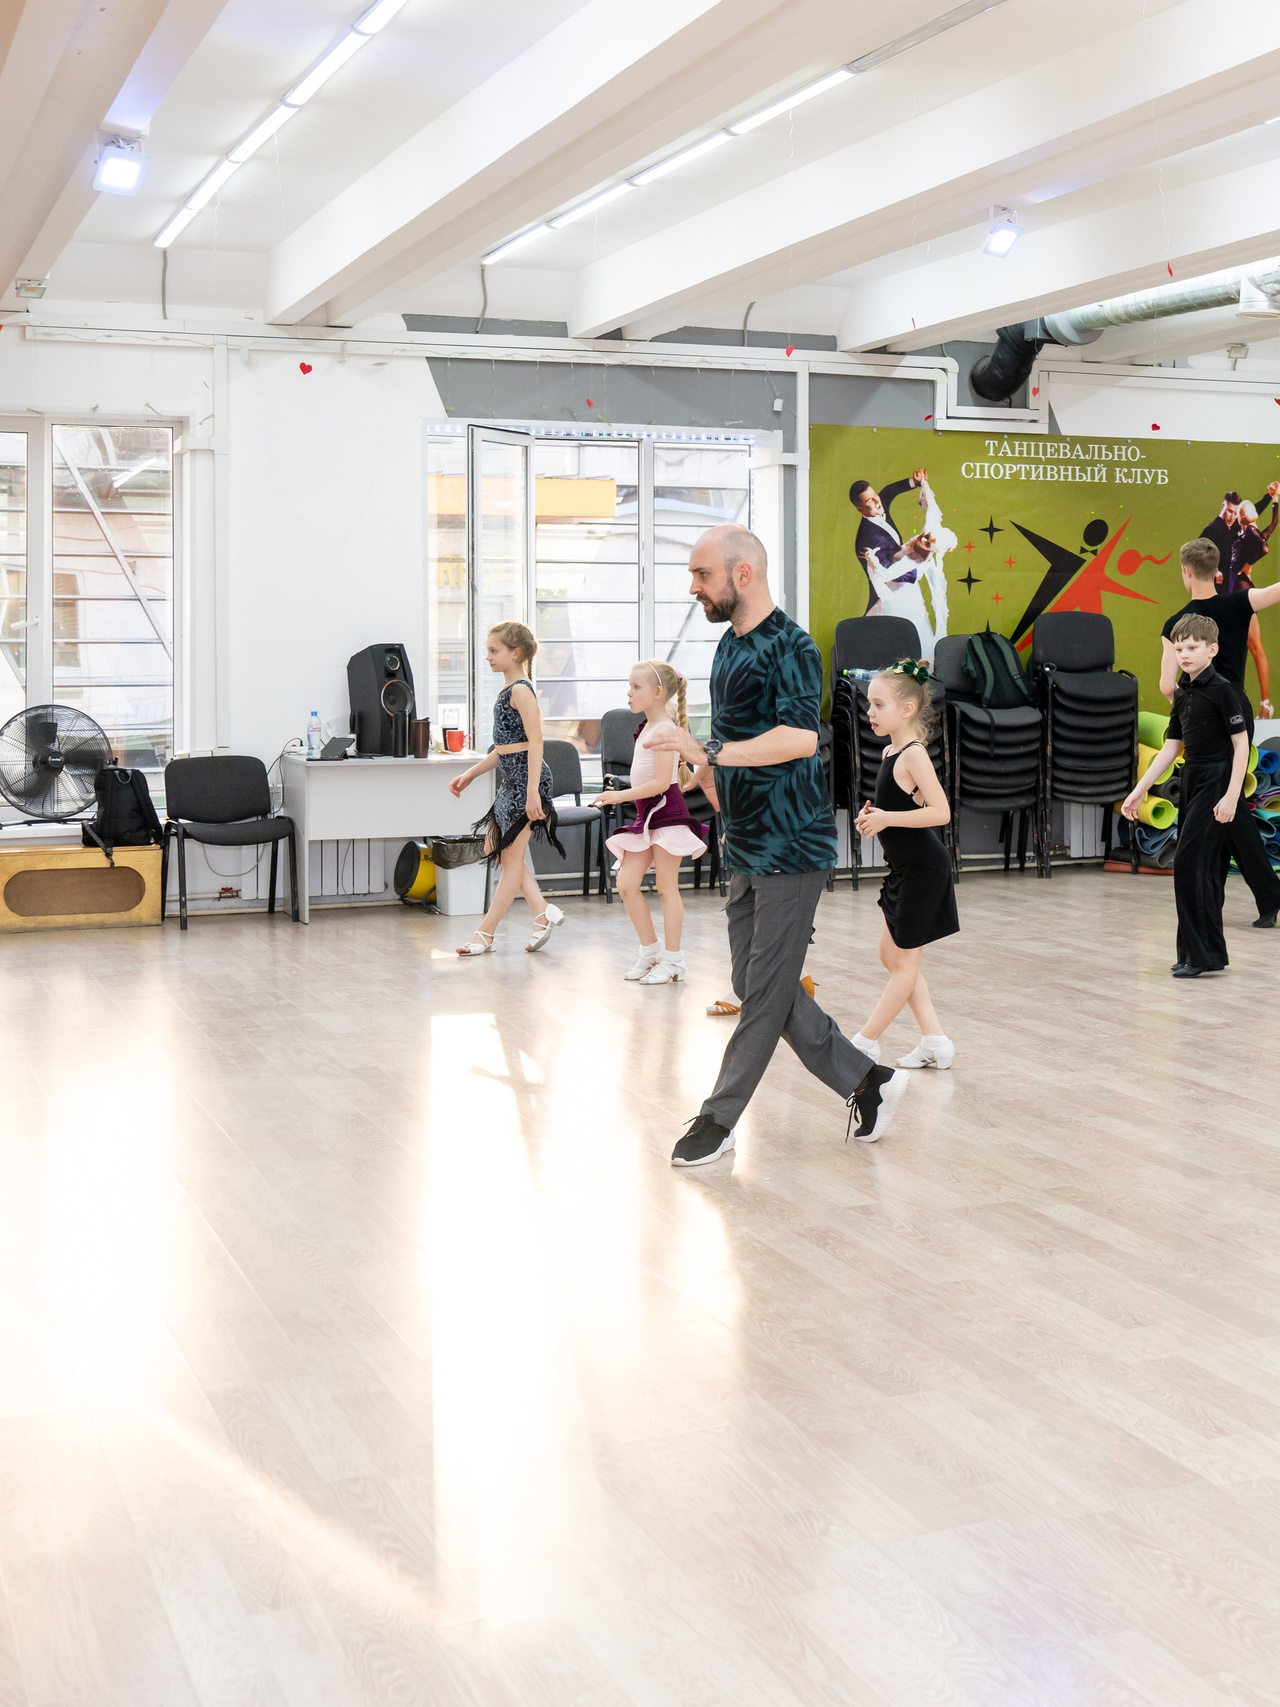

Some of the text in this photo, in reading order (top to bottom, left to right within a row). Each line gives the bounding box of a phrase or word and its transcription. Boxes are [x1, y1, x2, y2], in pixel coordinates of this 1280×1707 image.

[985, 440, 1146, 461] ТАНЦЕВАЛЬНО-
[961, 462, 1169, 485] СПОРТИВНЫЙ КЛУБ
